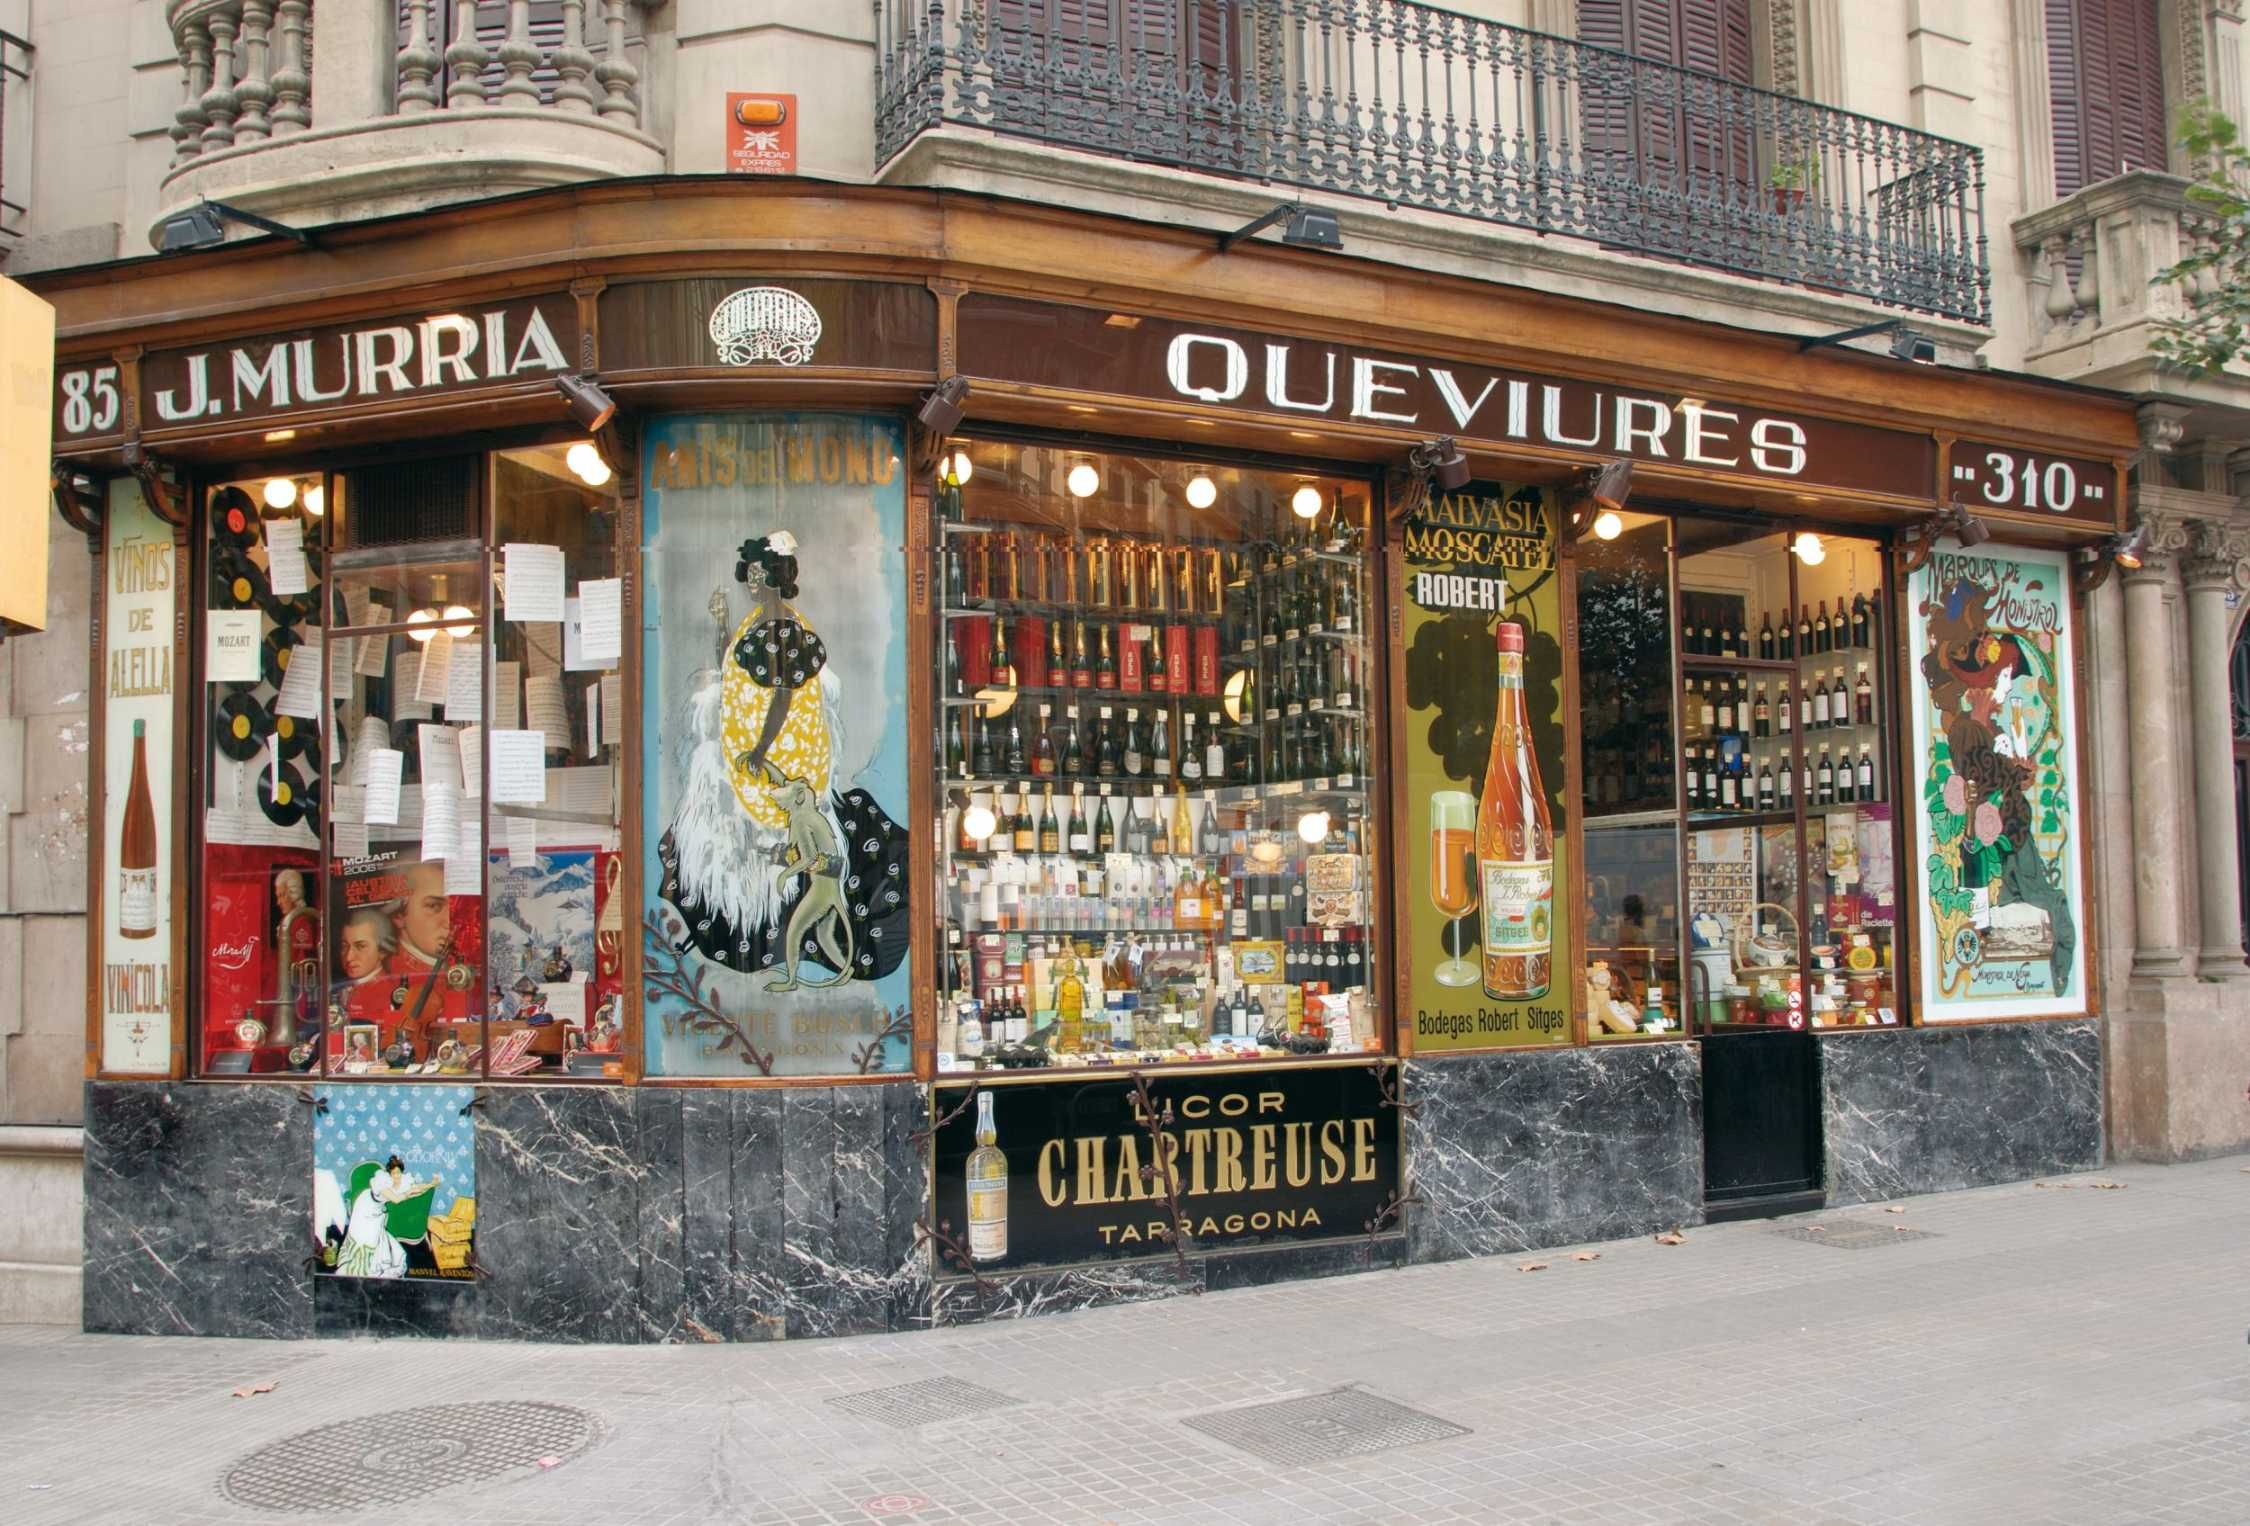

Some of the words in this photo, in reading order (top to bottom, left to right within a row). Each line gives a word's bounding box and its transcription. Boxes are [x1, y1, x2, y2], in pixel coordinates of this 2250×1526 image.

[62, 366, 120, 434] 85
[1166, 332, 1807, 476] QUEVIURES
[1983, 452, 2076, 512] 310
[1414, 492, 1552, 535] MALVASIA
[1403, 526, 1556, 571] MOSCATEL
[1416, 572, 1508, 611] ROBERT
[2001, 561, 2022, 584] DE
[128, 608, 154, 633] DE
[217, 635, 251, 648] MOZART
[110, 645, 171, 699] ALELLA
[343, 850, 398, 865] MOZART
[344, 863, 376, 876] 2006
[1860, 911, 1873, 919] die
[1861, 918, 1895, 927] Raclette
[1418, 1010, 1473, 1040] Bodegas
[1478, 1008, 1519, 1032] Robert
[1527, 1006, 1564, 1033] Sitges
[1037, 1117, 1376, 1208] CHARTREUSE
[1098, 1207, 1322, 1245] TARRAGONA
